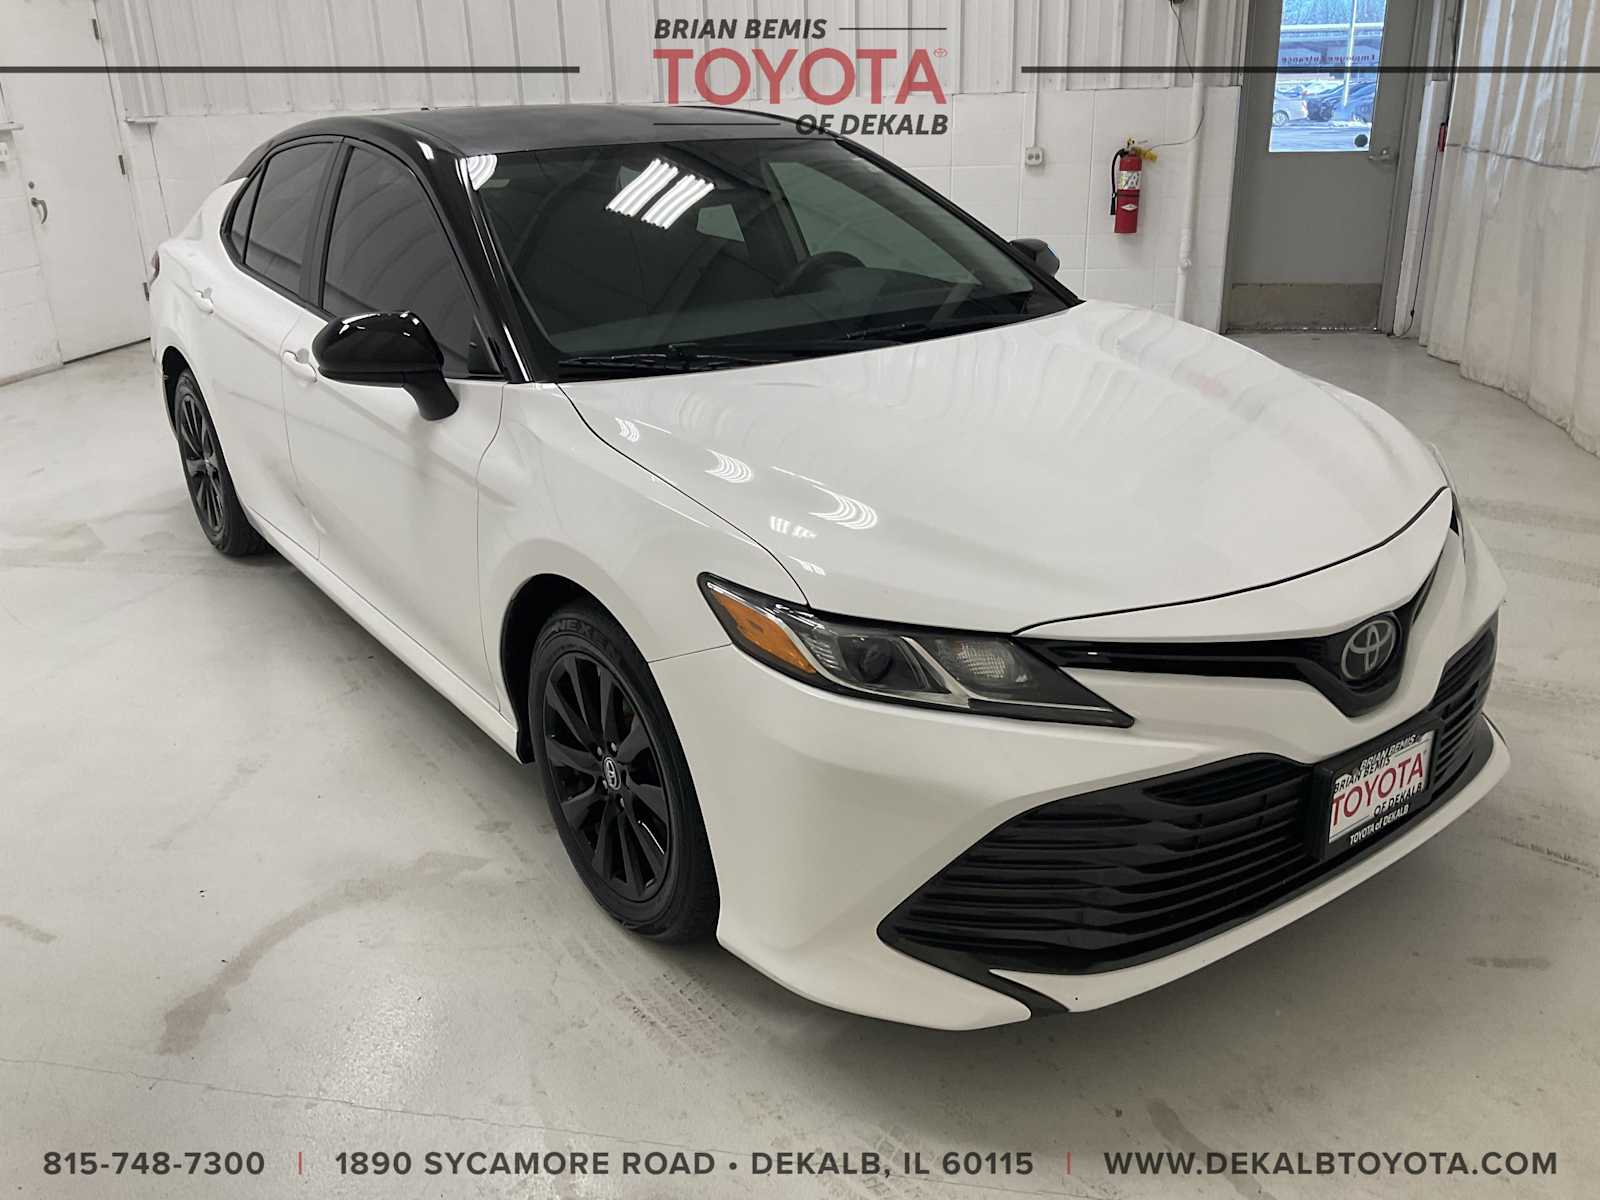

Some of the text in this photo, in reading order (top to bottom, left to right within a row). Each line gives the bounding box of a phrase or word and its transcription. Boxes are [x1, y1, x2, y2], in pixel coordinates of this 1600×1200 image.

[1360, 747, 1389, 771] BRIAN
[1331, 752, 1424, 826] TOYOTA
[1350, 822, 1375, 846] TOYOTA
[1383, 804, 1409, 827] DEKALB
